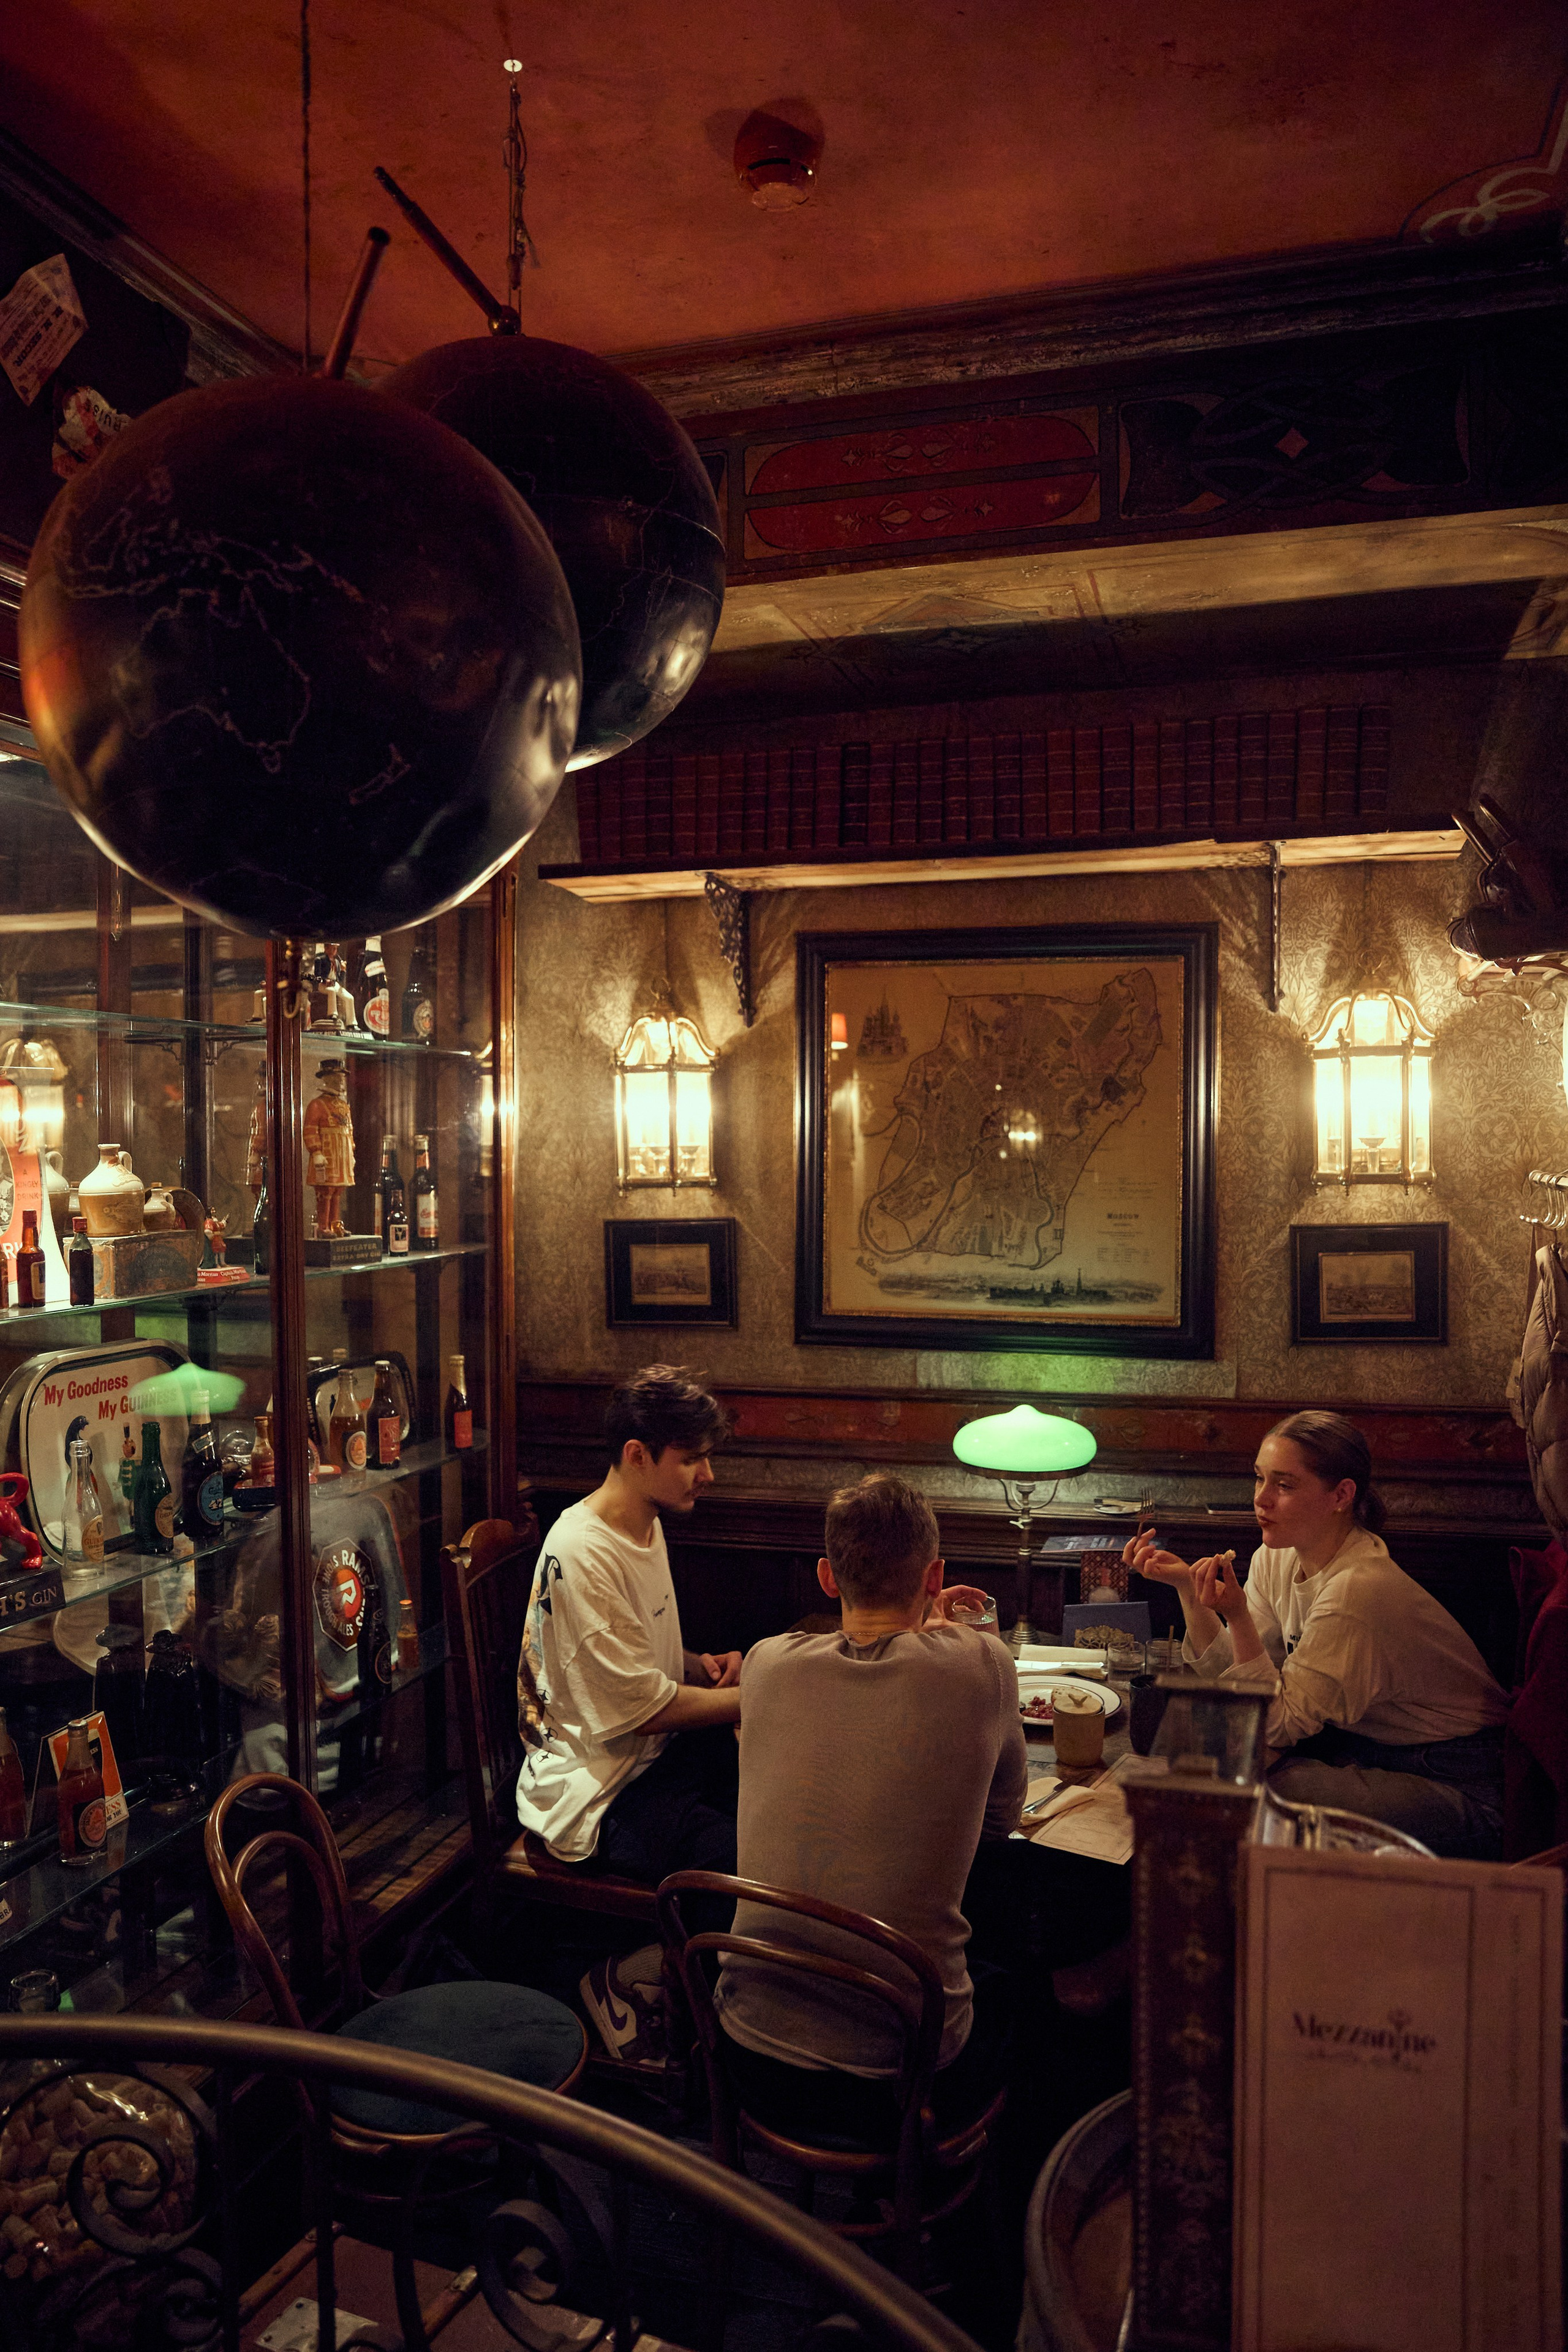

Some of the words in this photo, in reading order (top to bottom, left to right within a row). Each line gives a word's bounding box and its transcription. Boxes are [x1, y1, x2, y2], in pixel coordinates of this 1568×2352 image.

[336, 1243, 377, 1252] BEEFEATER
[45, 1385, 64, 1408] My
[67, 1375, 128, 1400] Goodness
[99, 1400, 117, 1420] My
[31, 1586, 58, 1605] GIN
[322, 1588, 339, 1629] TROUGH
[337, 1621, 354, 1637] ALES
[1292, 2011, 1437, 2054] Mezzanine
